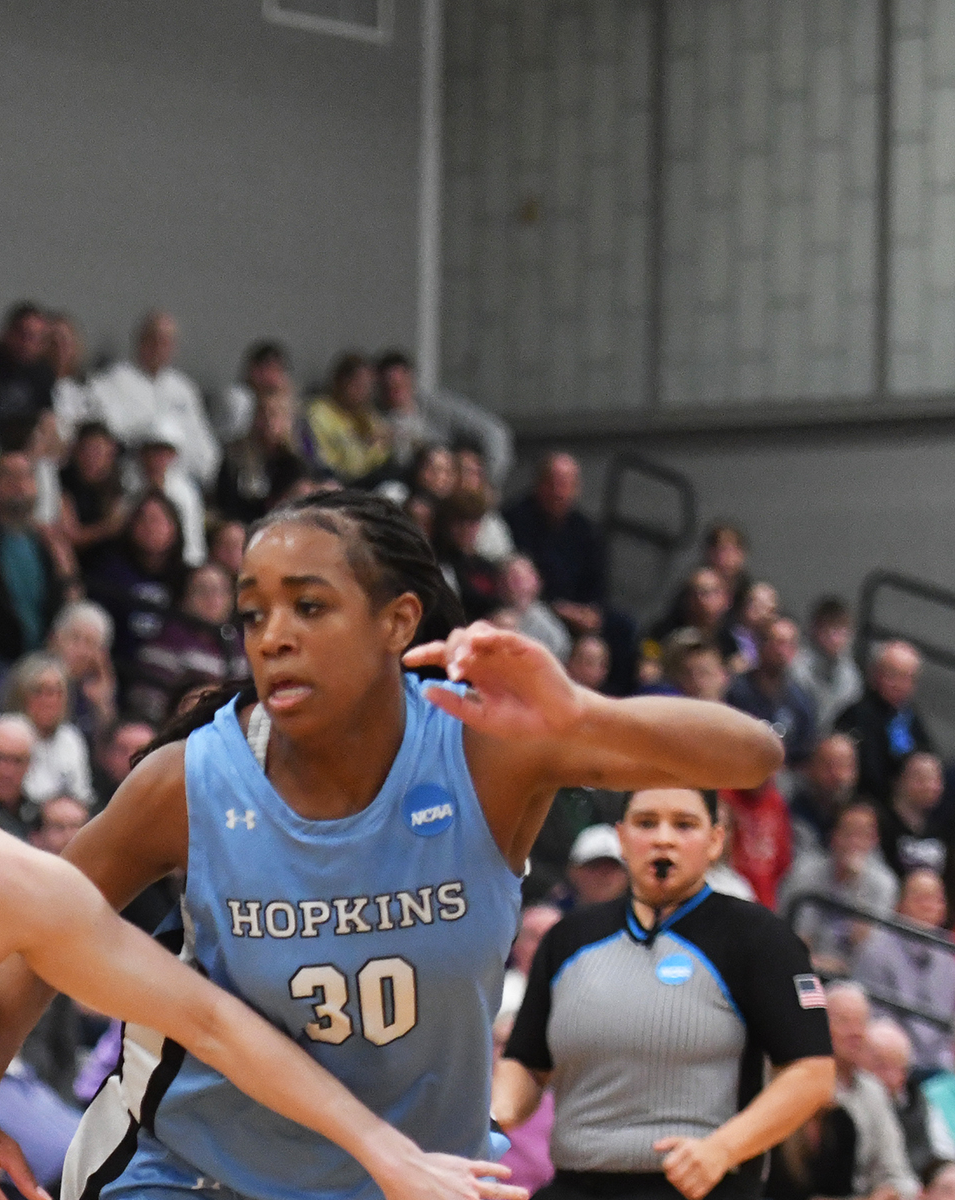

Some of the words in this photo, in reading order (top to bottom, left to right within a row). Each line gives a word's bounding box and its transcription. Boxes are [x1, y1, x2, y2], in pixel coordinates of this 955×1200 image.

[411, 803, 453, 826] NCAA
[227, 881, 468, 939] HOPKINS
[289, 955, 418, 1047] 30
